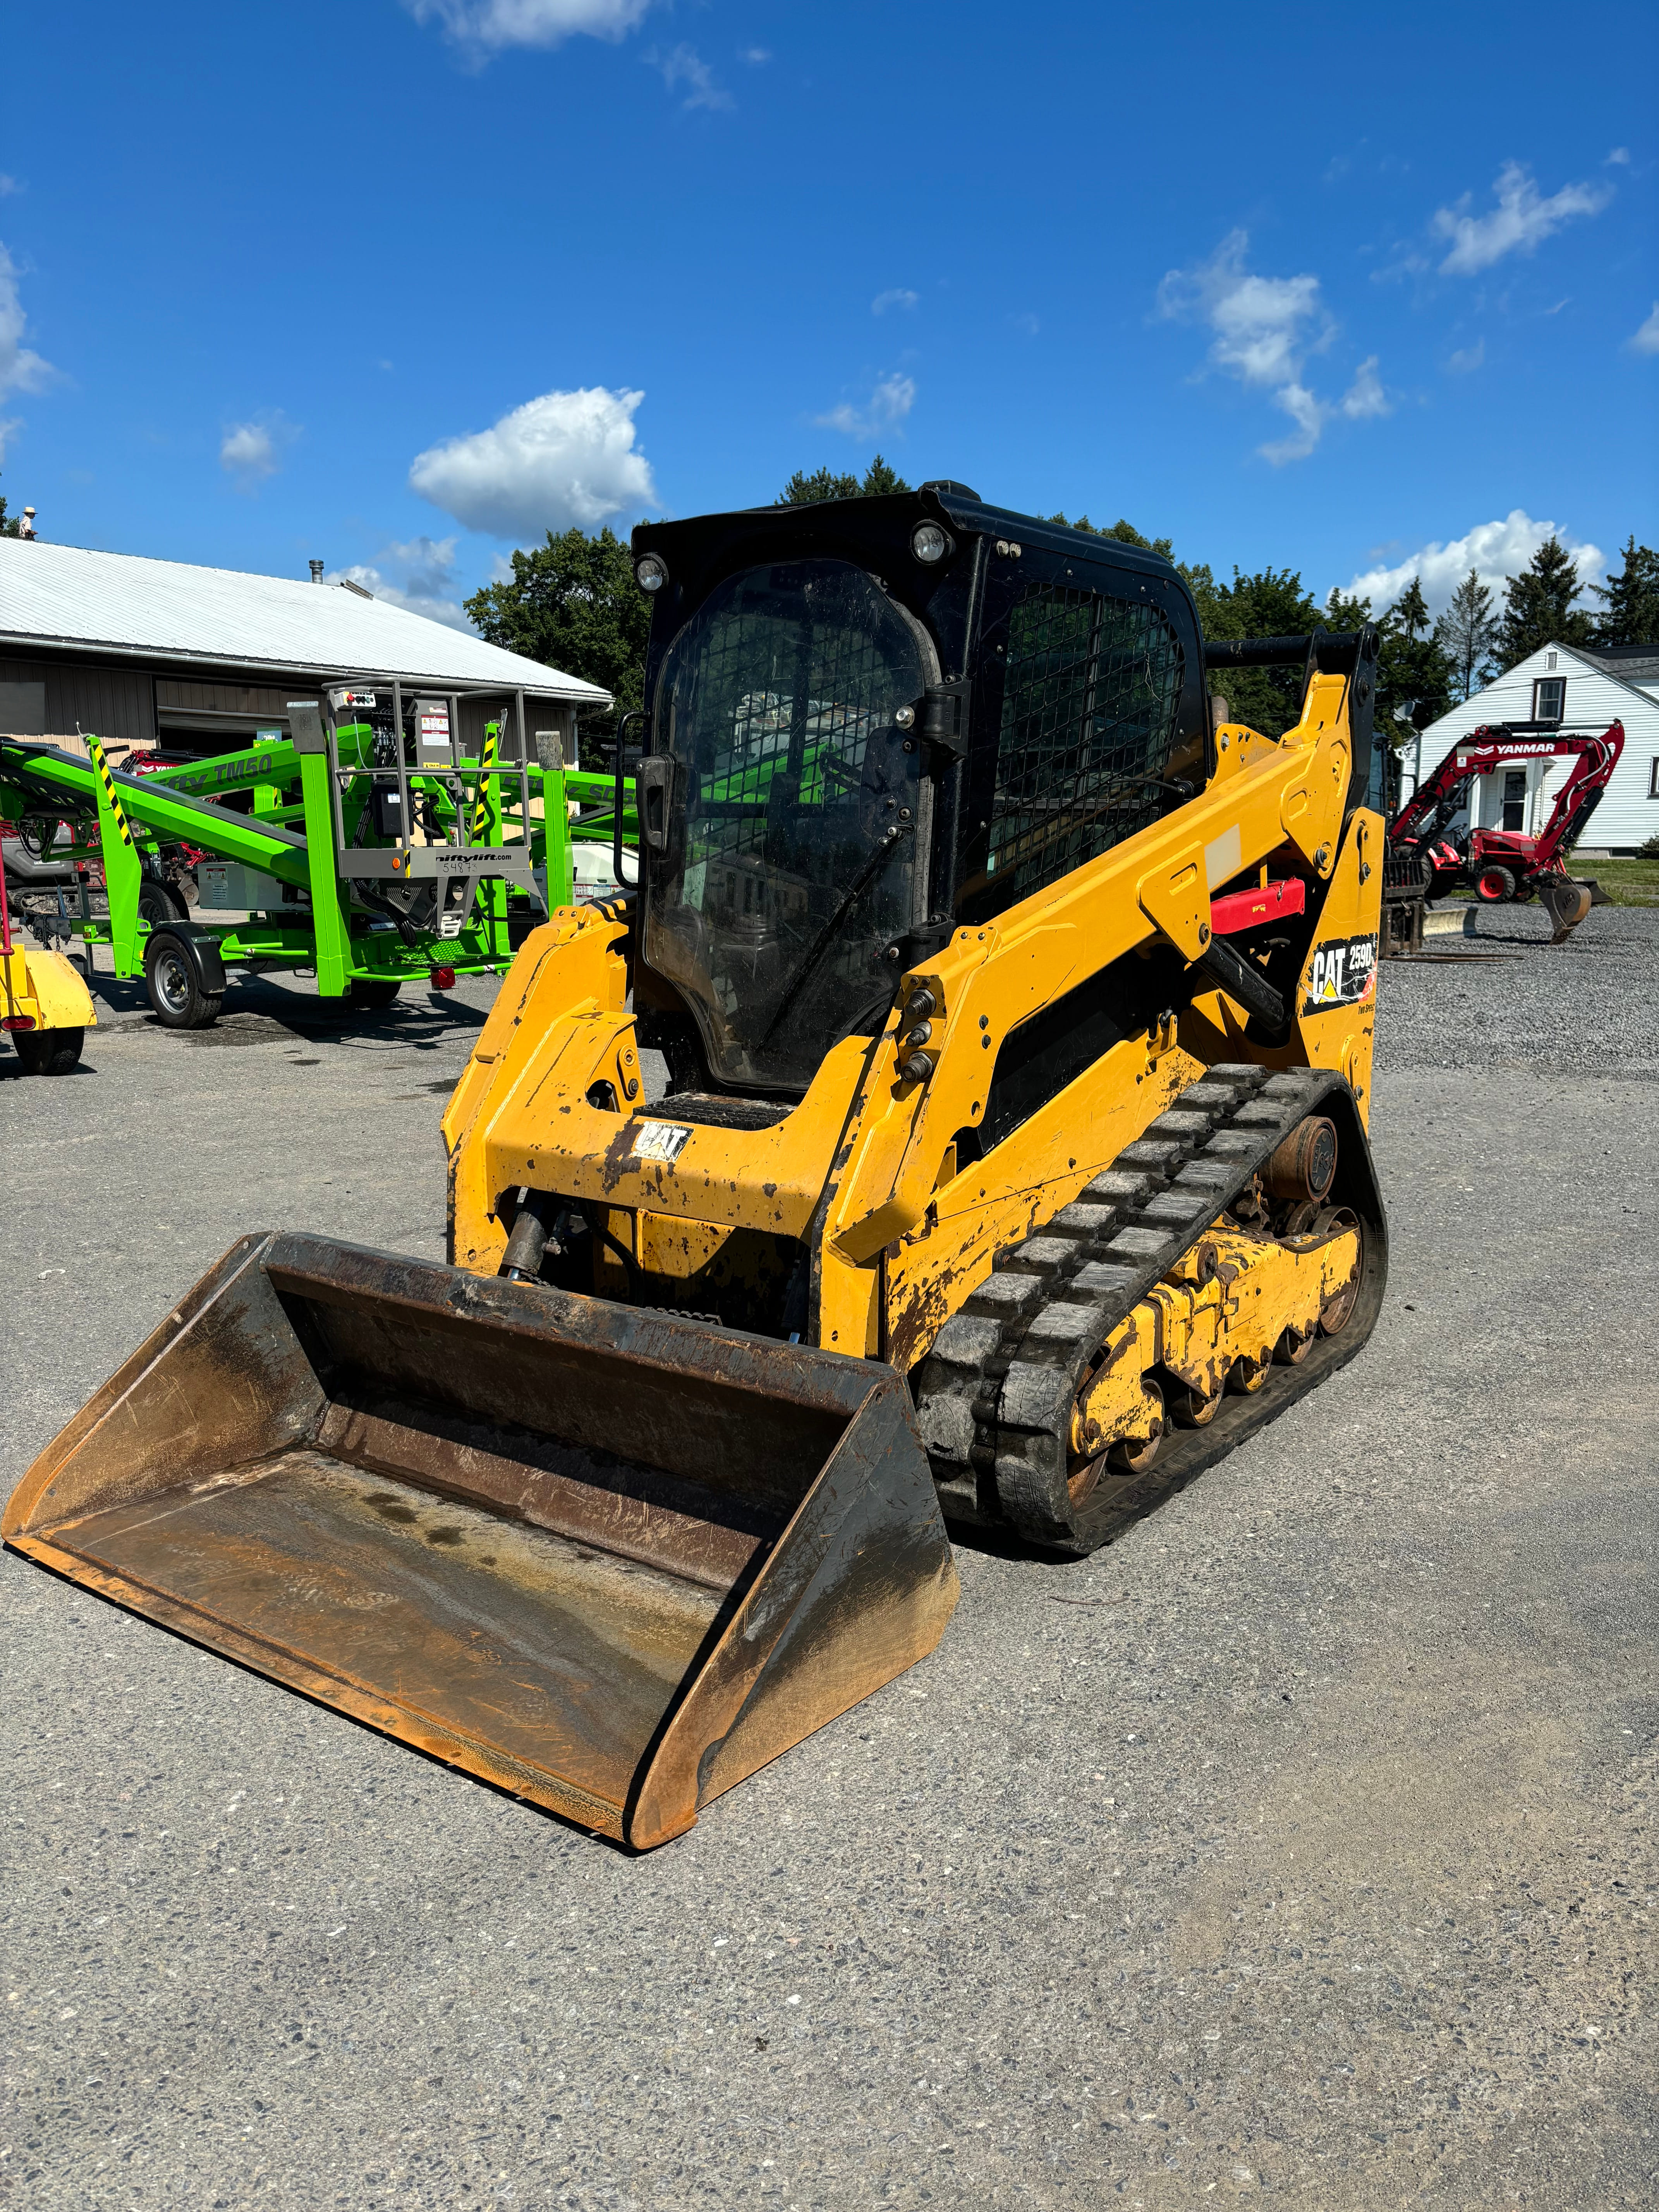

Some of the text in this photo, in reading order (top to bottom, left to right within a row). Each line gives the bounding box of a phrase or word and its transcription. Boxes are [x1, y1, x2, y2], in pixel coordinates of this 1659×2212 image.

[1497, 743, 1555, 754] YANMAR
[158, 754, 272, 791] ifty TM50
[589, 785, 637, 804] SD5
[436, 854, 512, 863] niftylift.com
[443, 862, 477, 874] 54873
[1312, 943, 1372, 1004] CAT 259D
[635, 1121, 687, 1158] CAT
